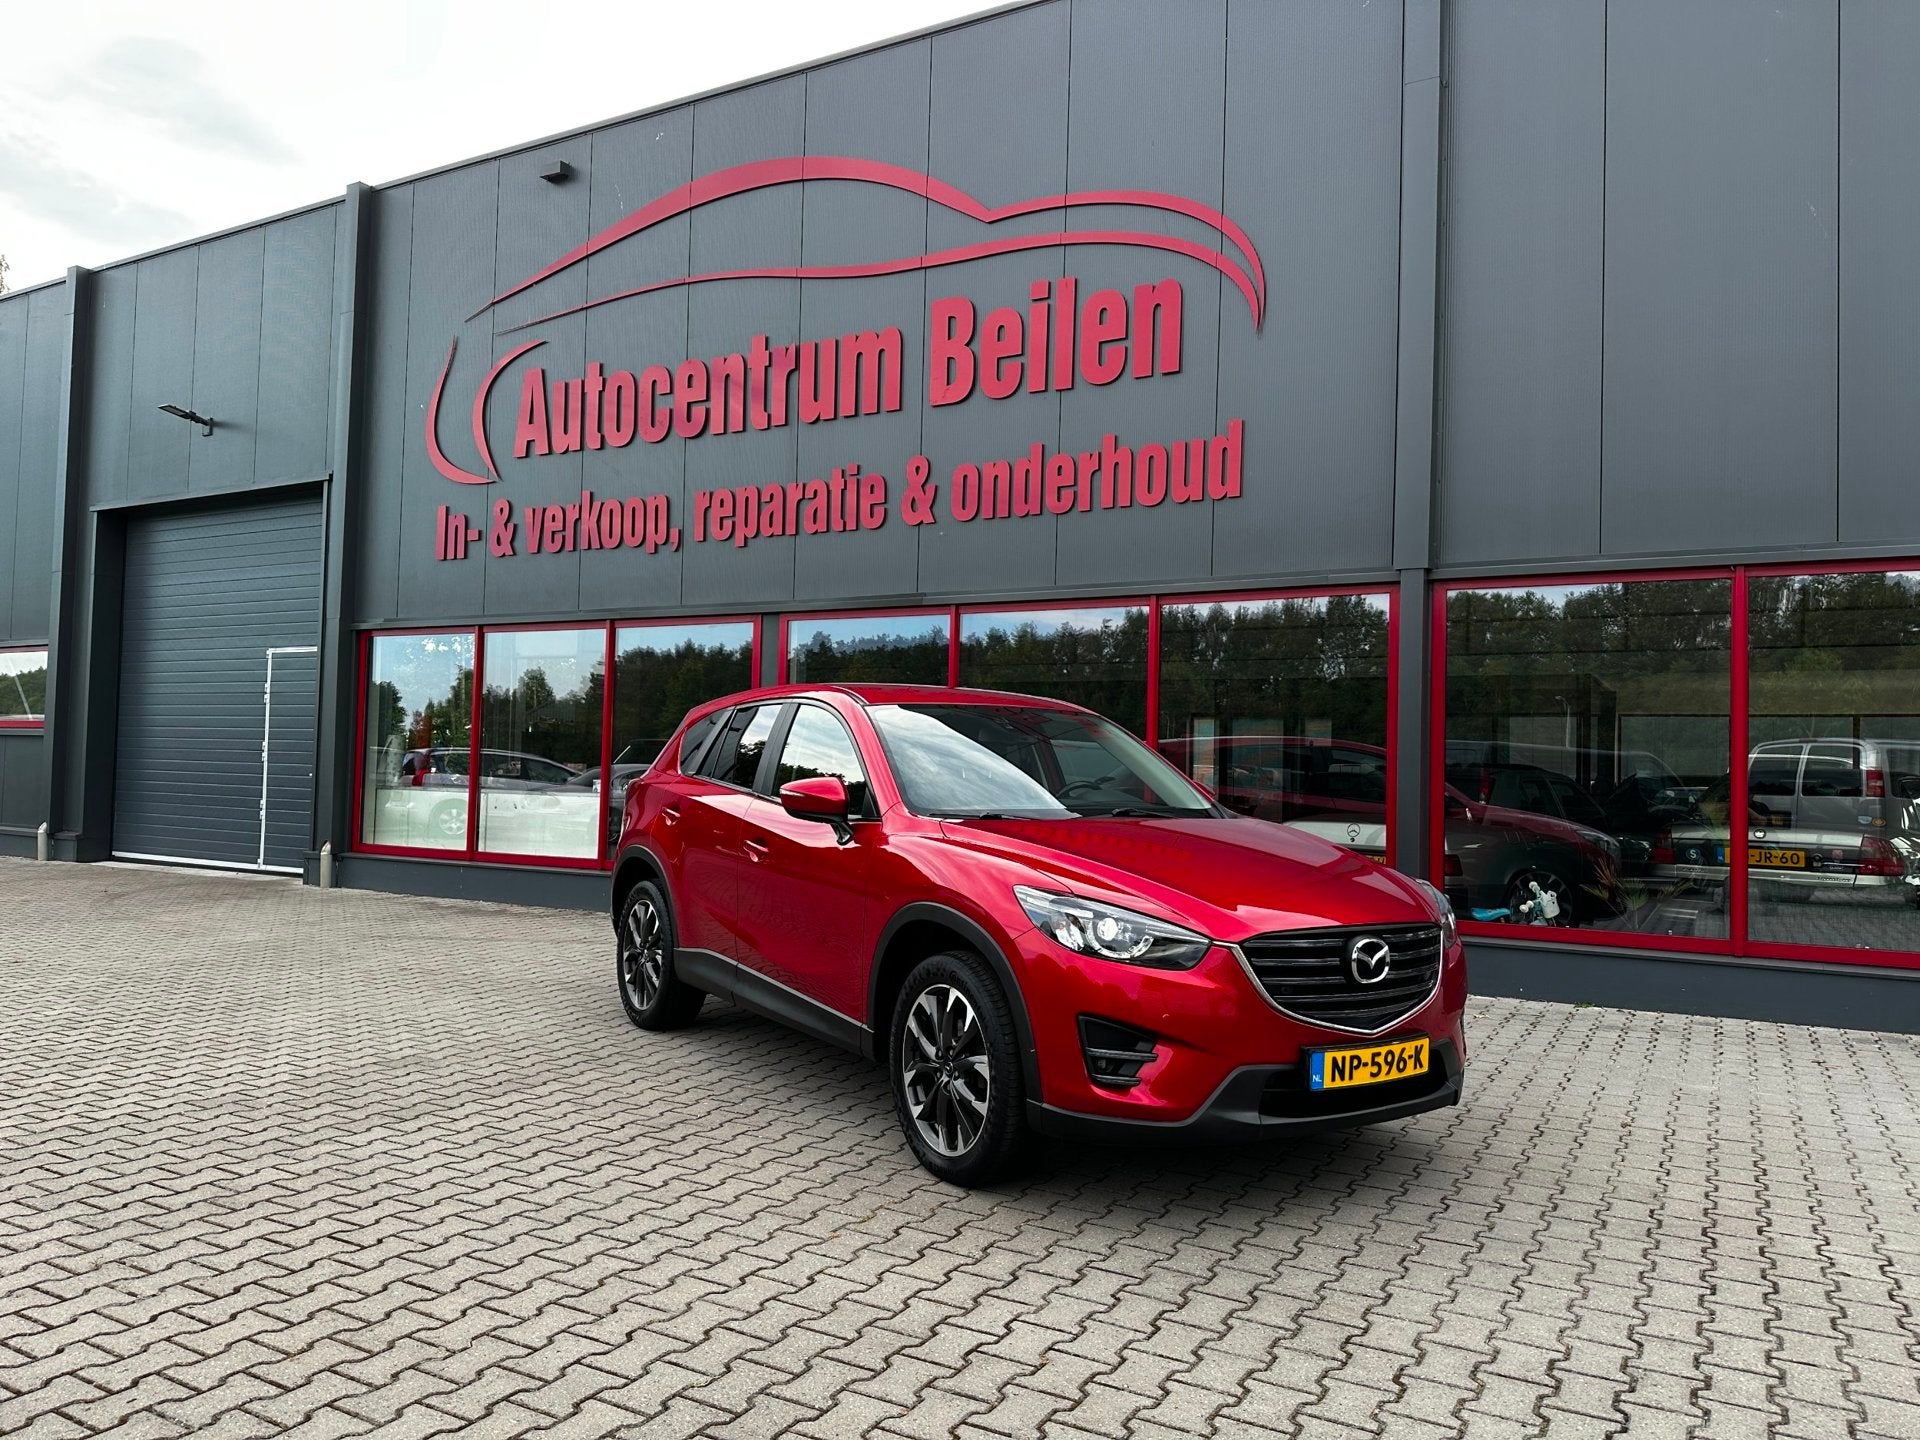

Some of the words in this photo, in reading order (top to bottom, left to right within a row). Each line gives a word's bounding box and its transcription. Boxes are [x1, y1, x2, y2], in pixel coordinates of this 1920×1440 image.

[513, 326, 903, 458] Autocentrum
[928, 276, 1182, 408] Beilen
[435, 504, 480, 560] In-
[489, 498, 518, 558] &
[524, 490, 680, 554] verkoop,
[693, 463, 887, 548] reparatie
[900, 454, 938, 527] &
[951, 418, 1244, 523] onderhoud
[1750, 851, 1801, 865] -JR-60
[1312, 1074, 1322, 1083] NL
[1330, 1043, 1425, 1082] NP-596-K
